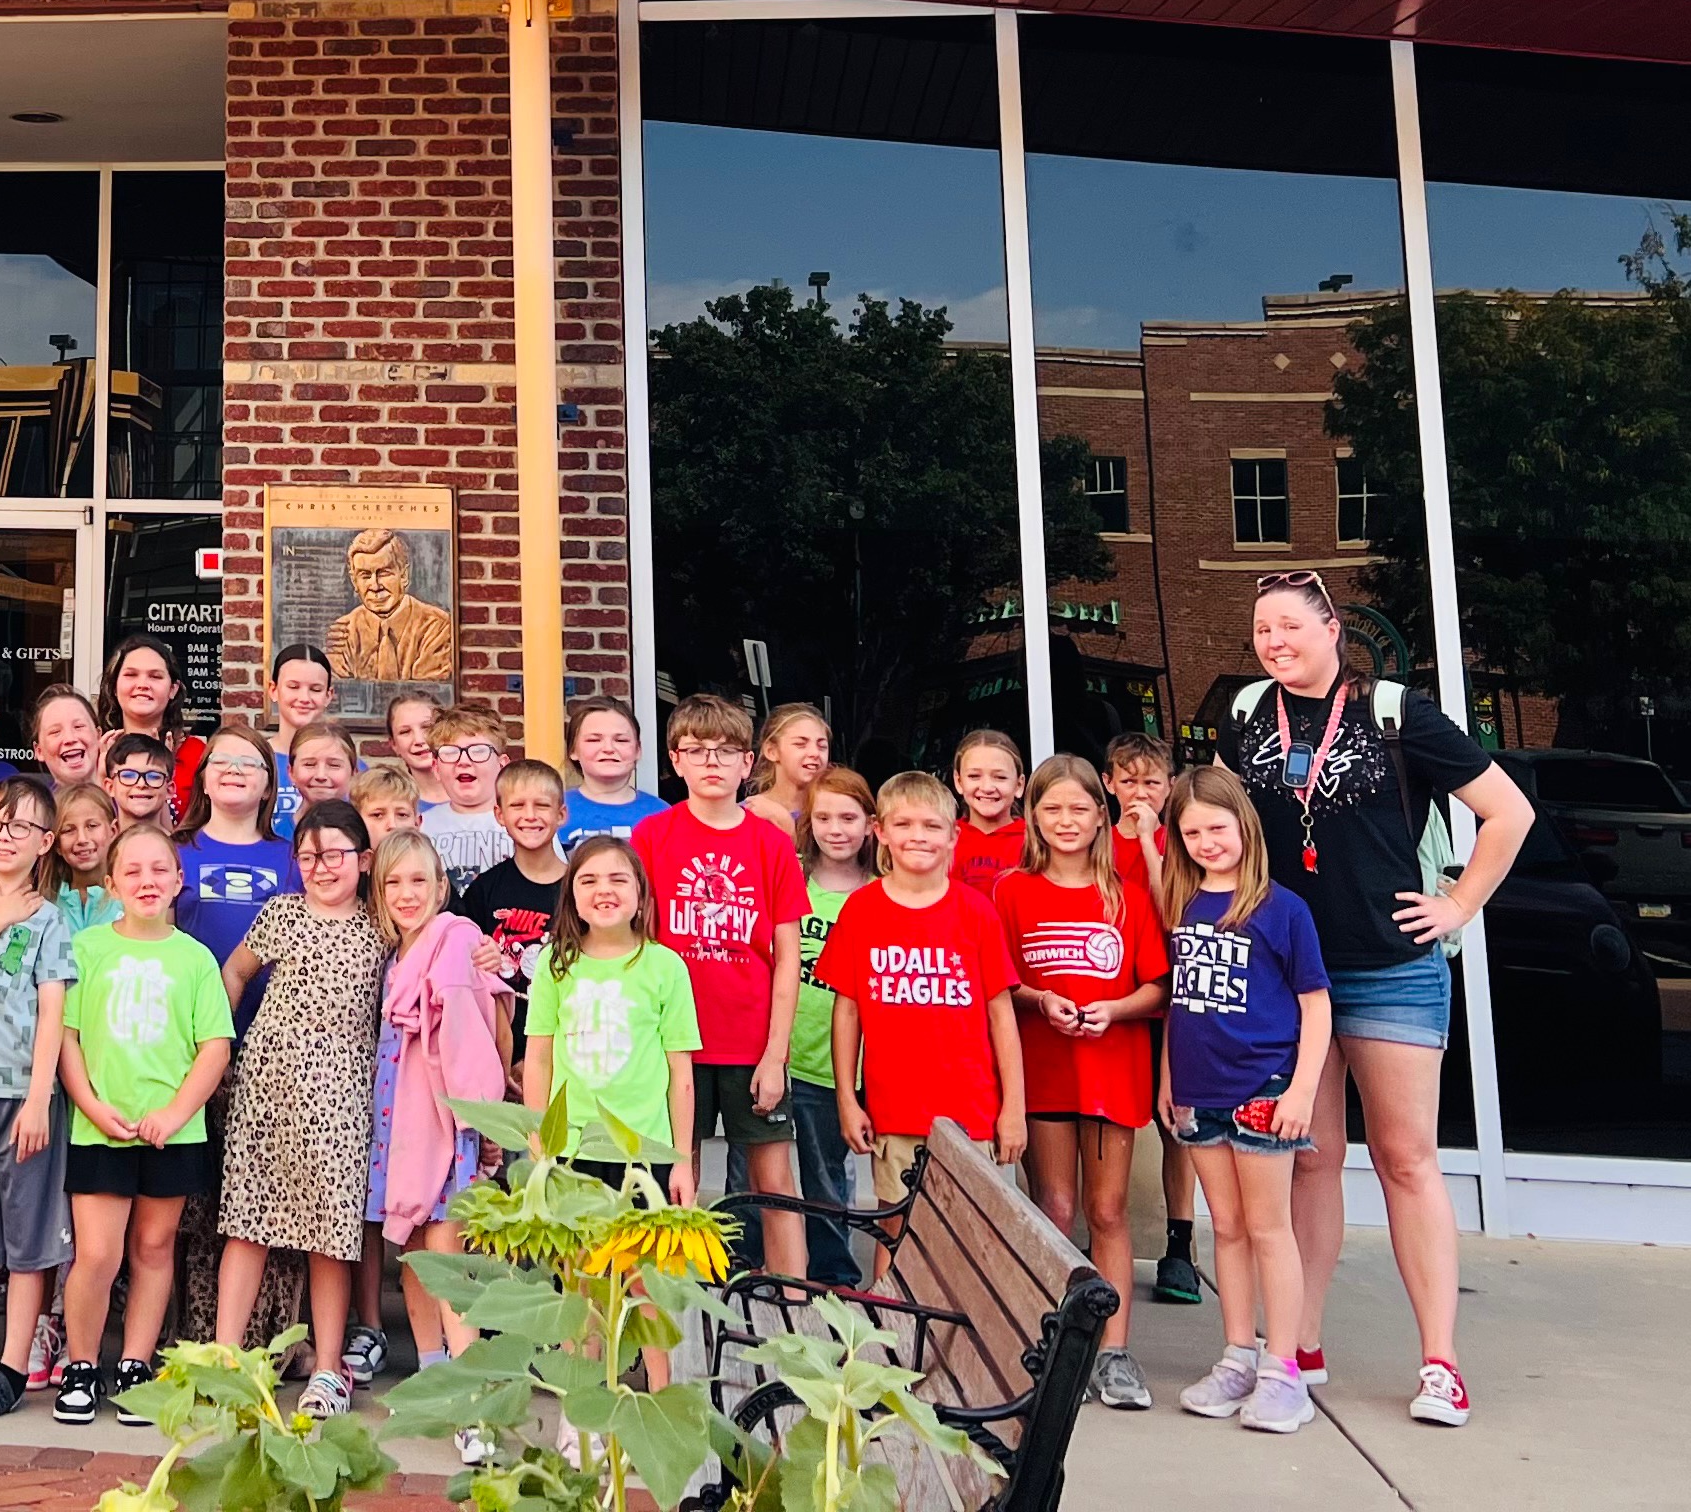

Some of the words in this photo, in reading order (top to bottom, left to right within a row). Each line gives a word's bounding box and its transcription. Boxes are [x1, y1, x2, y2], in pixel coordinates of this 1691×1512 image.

[285, 503, 336, 511] CHRIS
[351, 504, 440, 513] CHERCHES
[148, 603, 223, 622] CITYART
[147, 622, 176, 634] Hours
[177, 623, 188, 633] of
[189, 623, 223, 635] Operat
[1, 647, 13, 660] &
[16, 648, 61, 660] GIFTS
[187, 644, 209, 653] 9AM
[187, 655, 209, 664] 9AM
[187, 668, 209, 677] 9AM
[504, 908, 551, 933] NIKE
[870, 945, 952, 975] UDALL
[1172, 962, 1249, 1004] AGLES
[881, 975, 974, 1007] EAGLES
